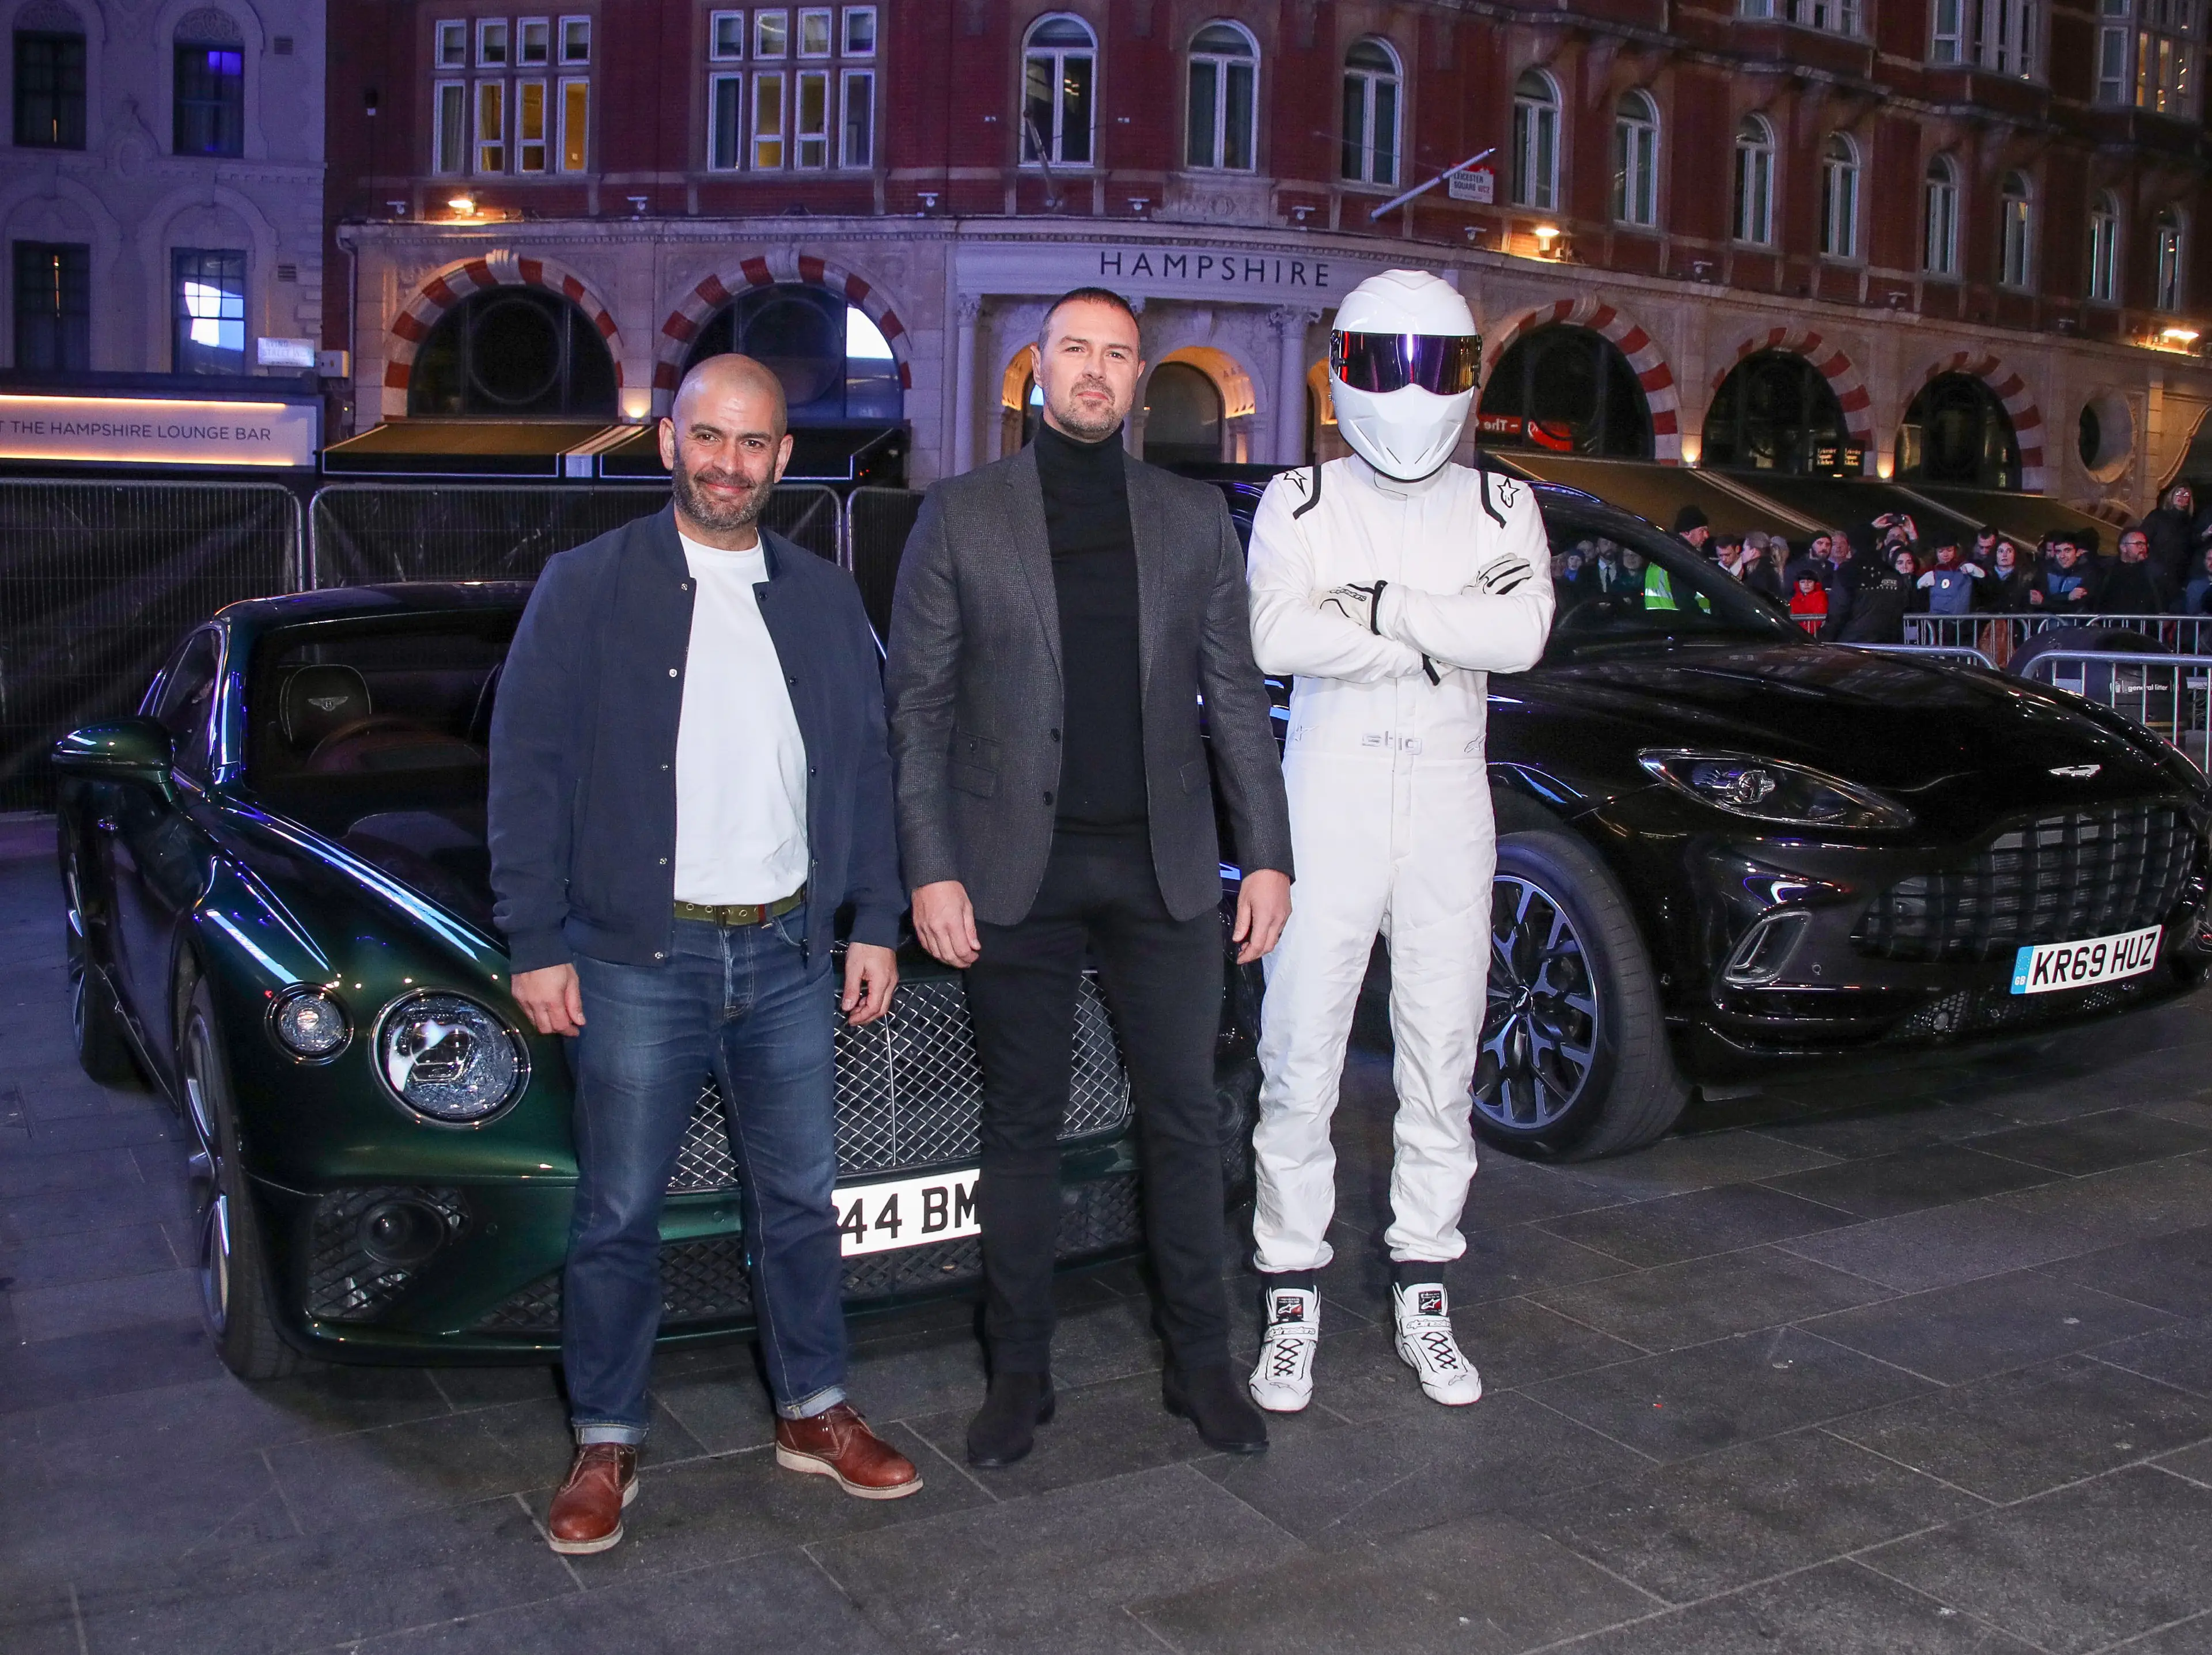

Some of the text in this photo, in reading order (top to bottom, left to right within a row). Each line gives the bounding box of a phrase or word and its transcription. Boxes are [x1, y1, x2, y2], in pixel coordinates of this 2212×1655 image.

[1454, 181, 1476, 191] SQUARE
[1100, 252, 1330, 287] HAMPSHIRE
[10, 421, 46, 434] THE
[51, 422, 152, 438] HAMPSHIRE
[157, 425, 229, 440] LOUNGE
[236, 427, 271, 441] BAR
[2032, 931, 2158, 986] KR69 HUZ
[2014, 975, 2027, 986] GB
[832, 1194, 902, 1244] 44
